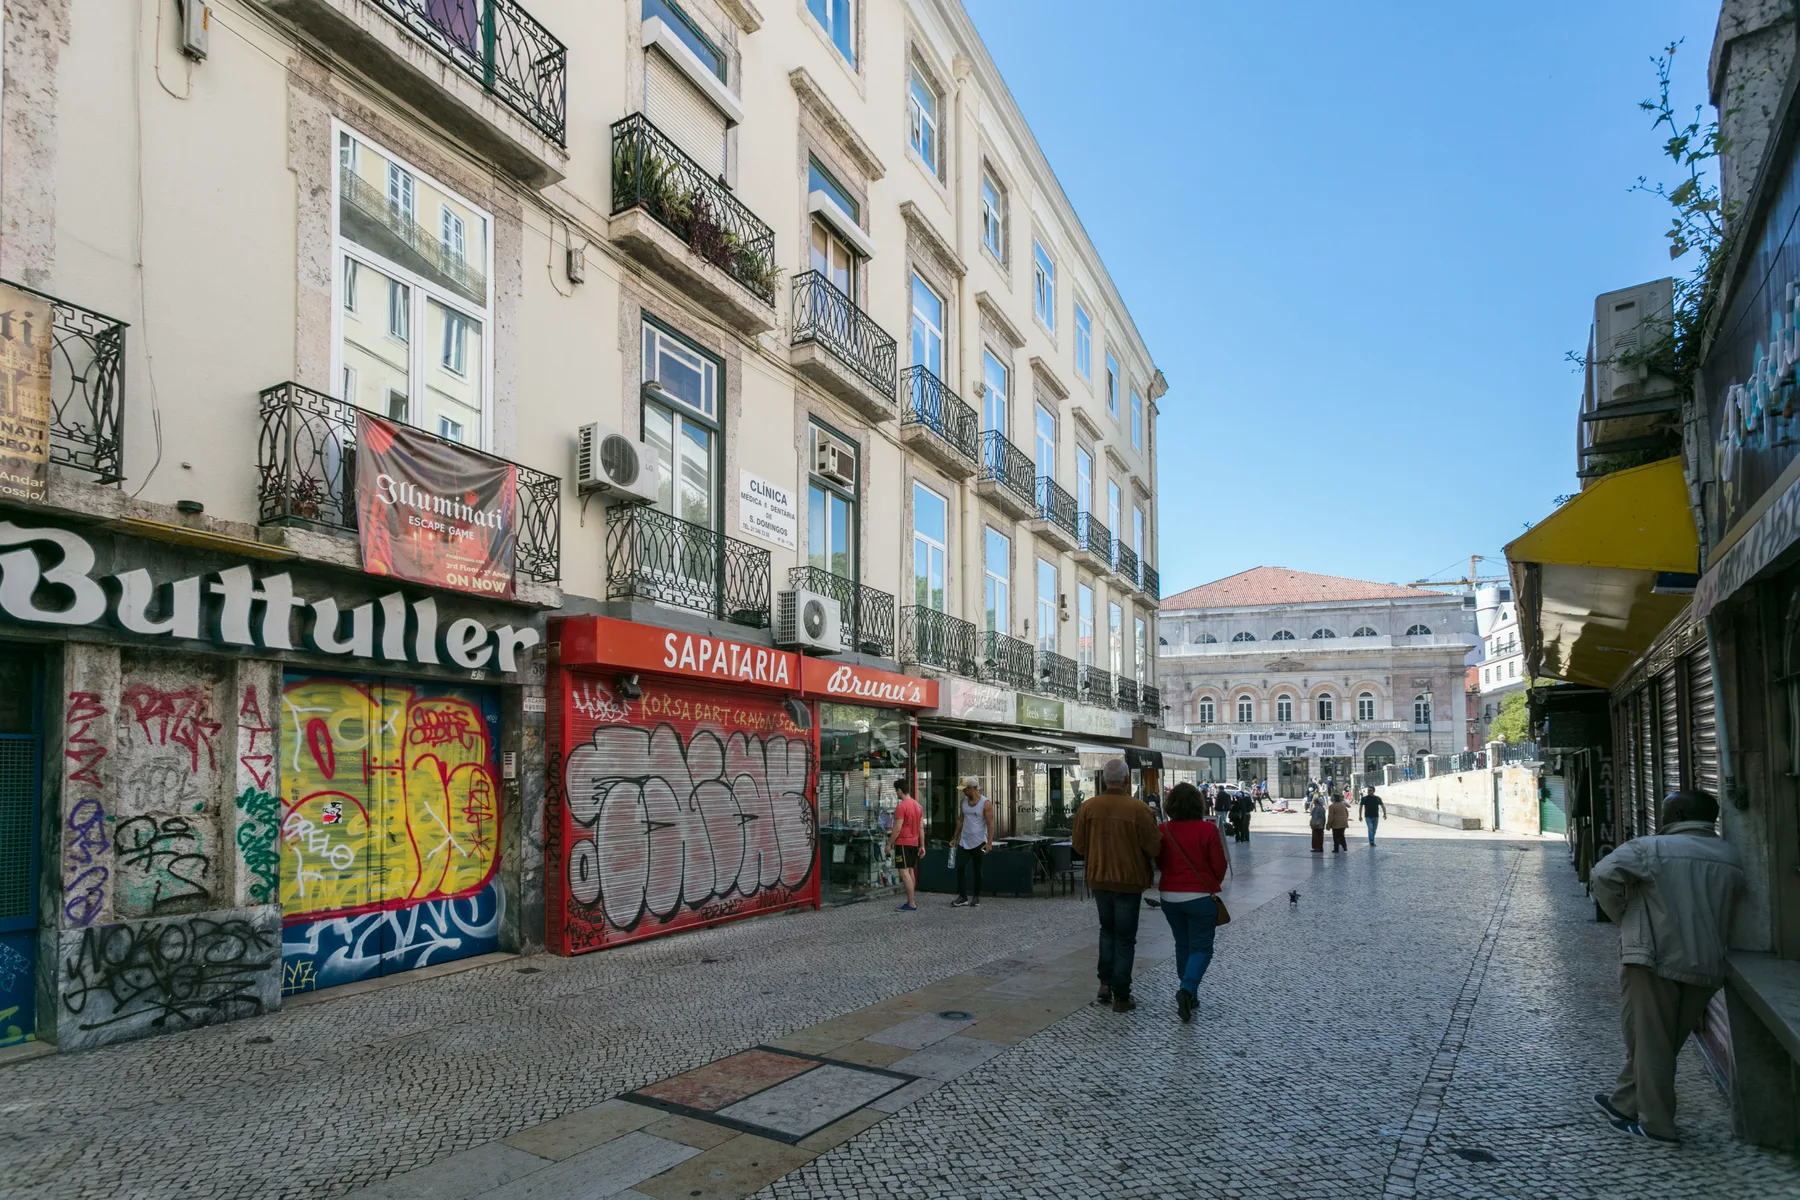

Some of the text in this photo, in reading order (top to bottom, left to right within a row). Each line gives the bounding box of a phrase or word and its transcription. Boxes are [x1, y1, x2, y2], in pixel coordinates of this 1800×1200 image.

[0, 471, 45, 488] Andar
[375, 473, 503, 531] Illuminati
[749, 479, 788, 506] CLÍNICA
[765, 512, 773, 520] DE
[408, 515, 474, 540] ESCAPE GAME
[756, 518, 788, 537] DOMINGOS
[445, 562, 458, 570] 3rd
[459, 564, 479, 573] Floor
[445, 572, 506, 594] ON NOW
[0, 519, 540, 673] Buttuller
[663, 632, 789, 685] SAPATARIA
[1017, 804, 1039, 814] feels
